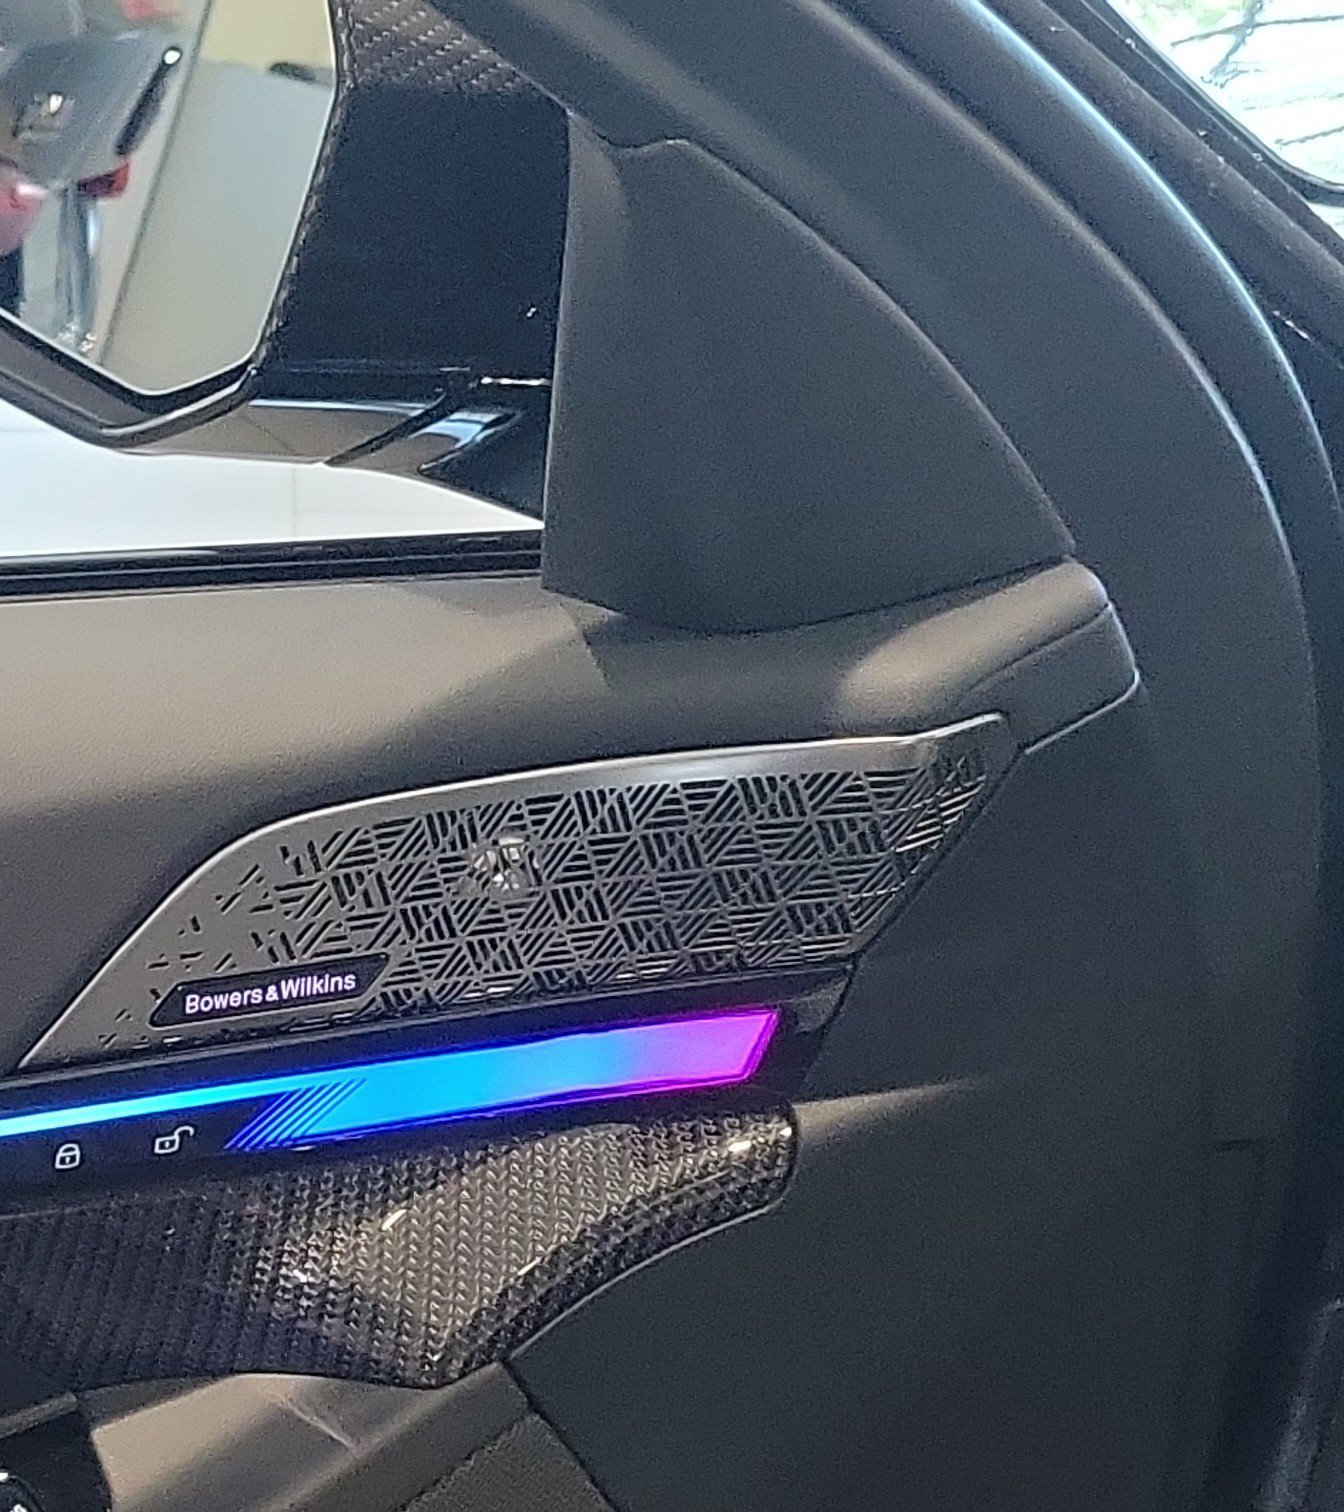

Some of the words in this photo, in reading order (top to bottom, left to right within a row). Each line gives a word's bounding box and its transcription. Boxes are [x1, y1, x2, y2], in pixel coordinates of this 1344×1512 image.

[185, 988, 263, 1014] Bowers
[265, 984, 279, 1002] &
[280, 973, 356, 1000] Wilkins
